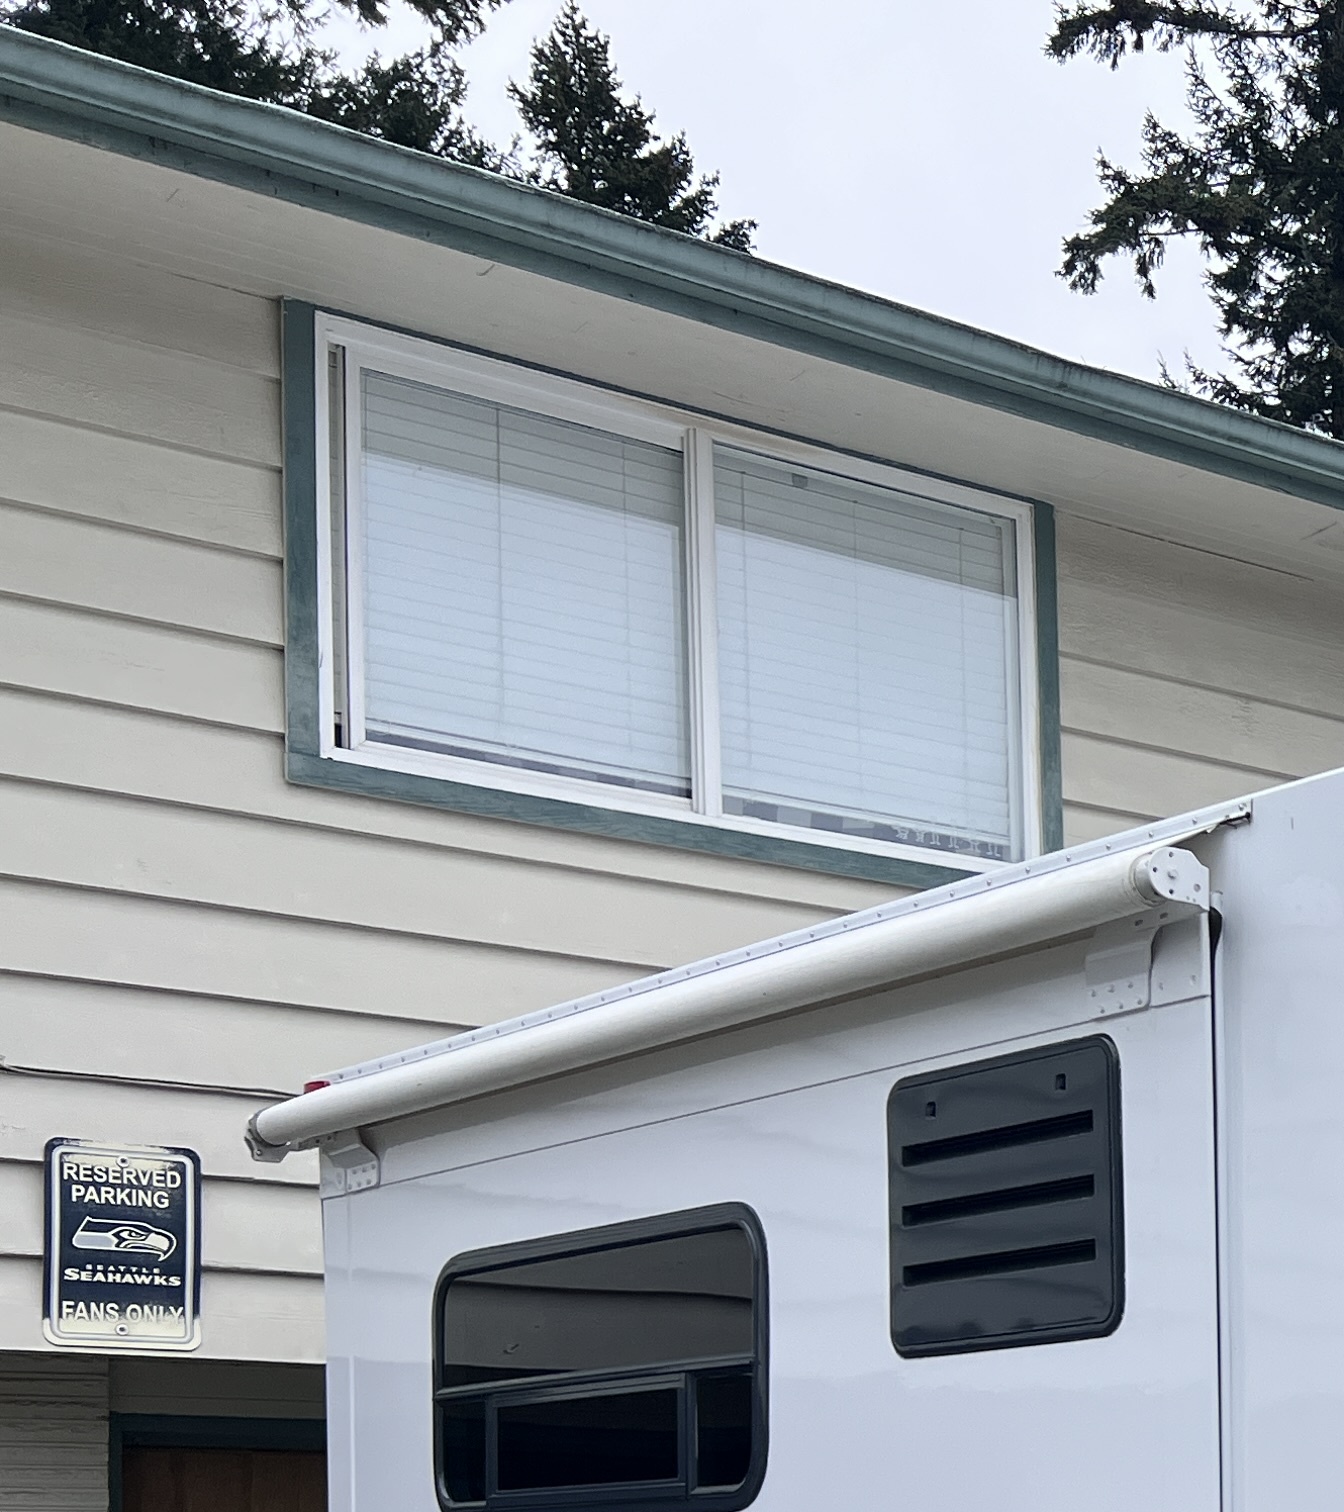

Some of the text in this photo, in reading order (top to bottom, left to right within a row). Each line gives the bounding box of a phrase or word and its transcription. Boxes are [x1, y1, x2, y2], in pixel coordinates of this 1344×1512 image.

[63, 1163, 181, 1188] RESERVED
[71, 1184, 170, 1209] PARKING
[63, 1267, 182, 1287] SEAHAWKS
[85, 1264, 160, 1274] SEATTLE
[61, 1300, 184, 1324] FANS ONLY
